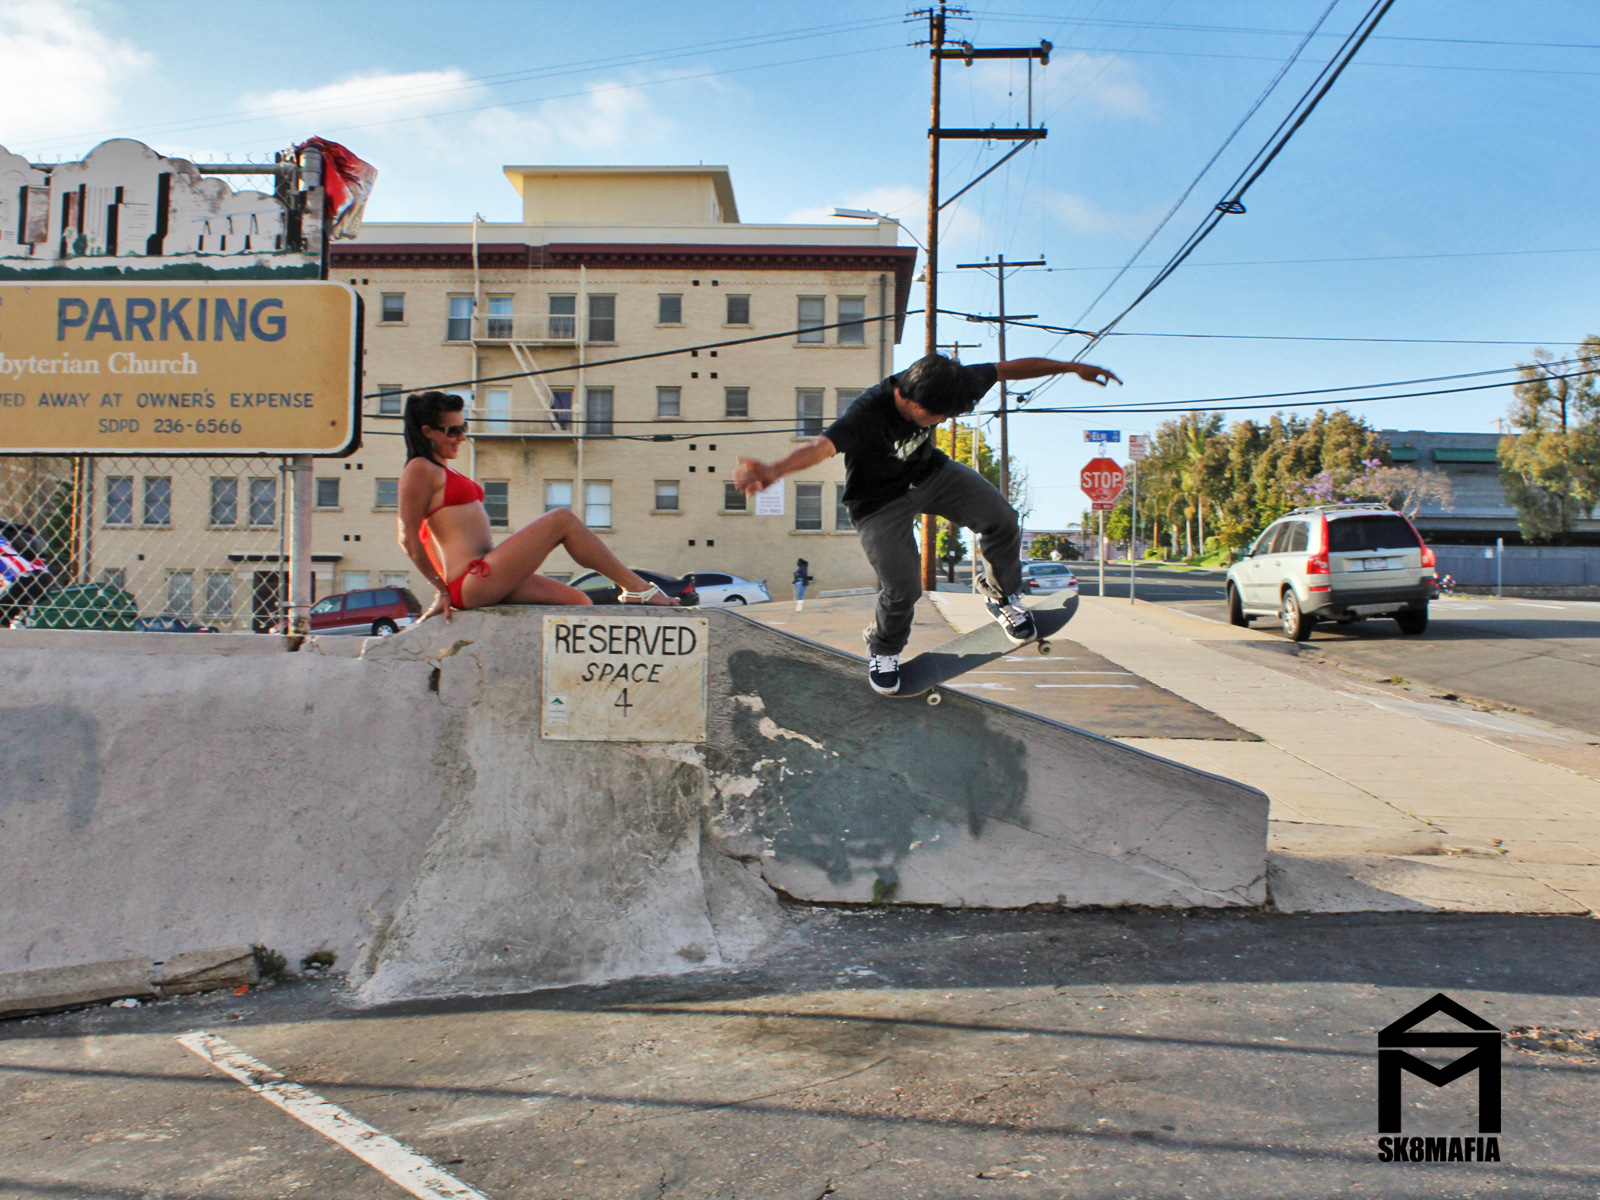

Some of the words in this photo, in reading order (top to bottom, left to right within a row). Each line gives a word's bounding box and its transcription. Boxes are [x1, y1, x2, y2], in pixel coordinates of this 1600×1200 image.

[57, 297, 287, 342] PARKING
[108, 352, 198, 375] Church
[0, 393, 25, 407] ED
[38, 393, 90, 408] AWAY
[100, 393, 123, 408] AT
[137, 388, 216, 408] OWNER'S
[230, 393, 314, 408] EXPENSE
[98, 418, 140, 434] SDPD
[153, 418, 242, 434] 236-6566
[1082, 472, 1122, 488] STOP
[555, 624, 697, 656] RESERVED
[581, 662, 664, 683] SPACE
[614, 687, 633, 718] 4
